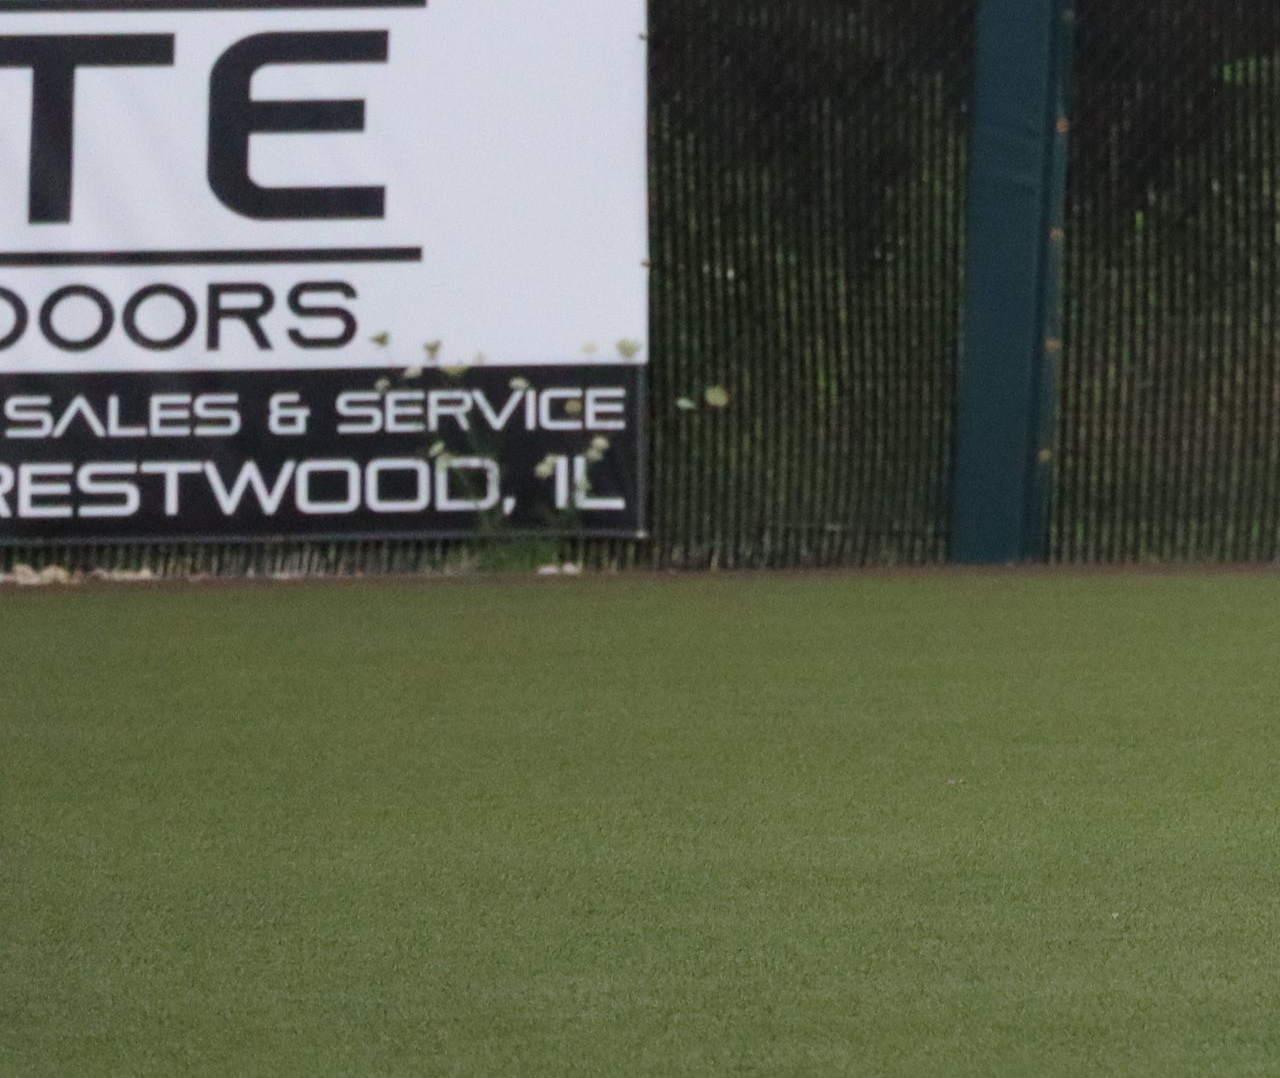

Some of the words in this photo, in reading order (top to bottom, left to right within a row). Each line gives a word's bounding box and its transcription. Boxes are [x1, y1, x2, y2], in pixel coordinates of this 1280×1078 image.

[4, 393, 241, 438] SALES
[268, 393, 310, 435] &
[336, 388, 626, 433] SERVICE
[0, 456, 516, 518] ESTWOOD,
[554, 455, 626, 511] IL
